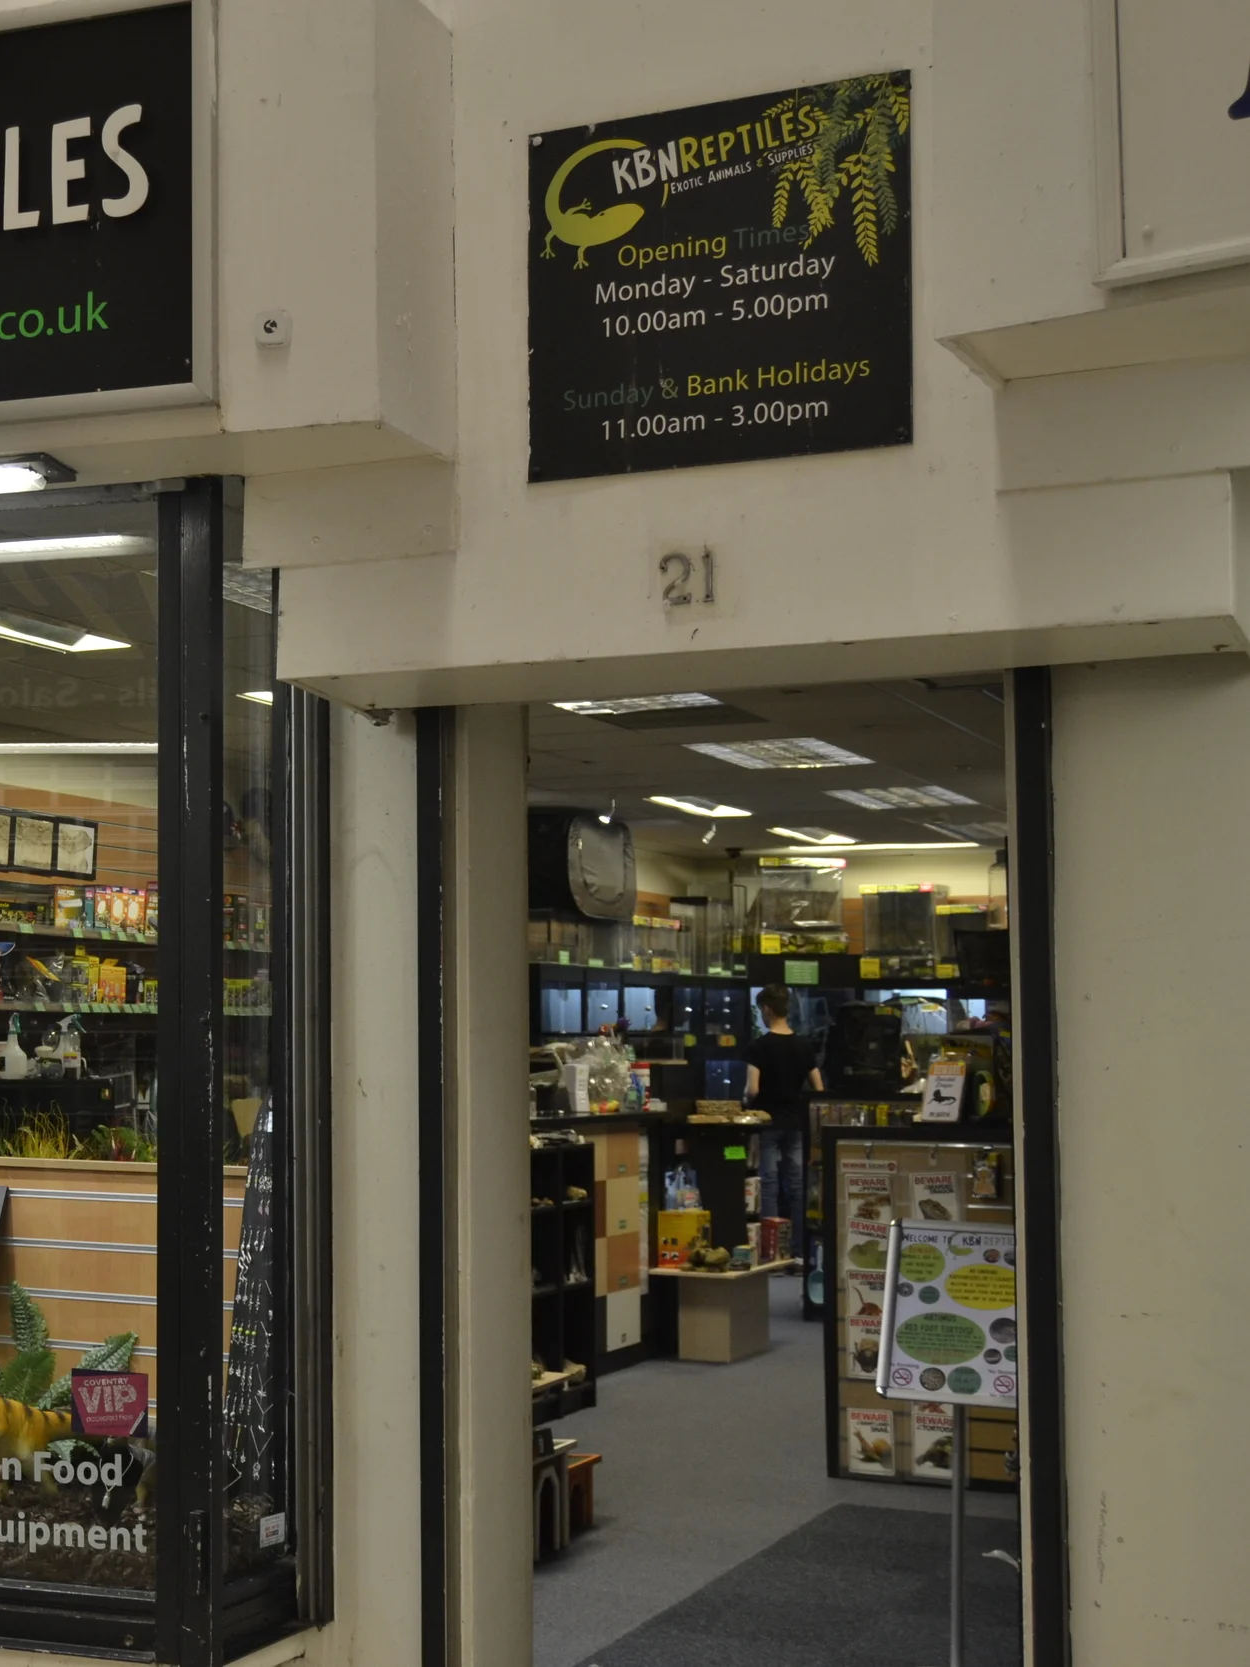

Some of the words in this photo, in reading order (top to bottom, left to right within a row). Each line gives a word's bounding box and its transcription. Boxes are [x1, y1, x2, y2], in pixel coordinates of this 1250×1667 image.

[670, 174, 704, 195] EXOTIC
[707, 160, 753, 184] ANIMALS
[767, 143, 815, 167] SUPPLIES
[617, 234, 726, 270] Opening
[733, 223, 810, 250] Times
[595, 272, 696, 305] Monday
[720, 253, 836, 288] Saturday
[601, 308, 706, 338] 10.00am
[731, 291, 829, 322] 5.00pm
[562, 381, 655, 412] Sunday
[662, 378, 680, 400] &
[686, 368, 750, 397] Bank
[756, 357, 871, 389] Holidays
[601, 412, 706, 441] 11.00am
[731, 398, 829, 429] 3.00pm
[659, 548, 714, 606] 21
[849, 1178, 887, 1187] BEWARE
[915, 1175, 954, 1185] BEWARE
[850, 1221, 887, 1233] BEWARE
[902, 1233, 938, 1243] WELCOME
[962, 1236, 982, 1246] KBN
[984, 1236, 1015, 1247] REPTIL
[850, 1319, 882, 1327] BEWAR
[83, 1377, 128, 1386] COVENTRY
[78, 1384, 137, 1413] VIP
[851, 1412, 888, 1422] BEWARE
[34, 1451, 123, 1487] Food
